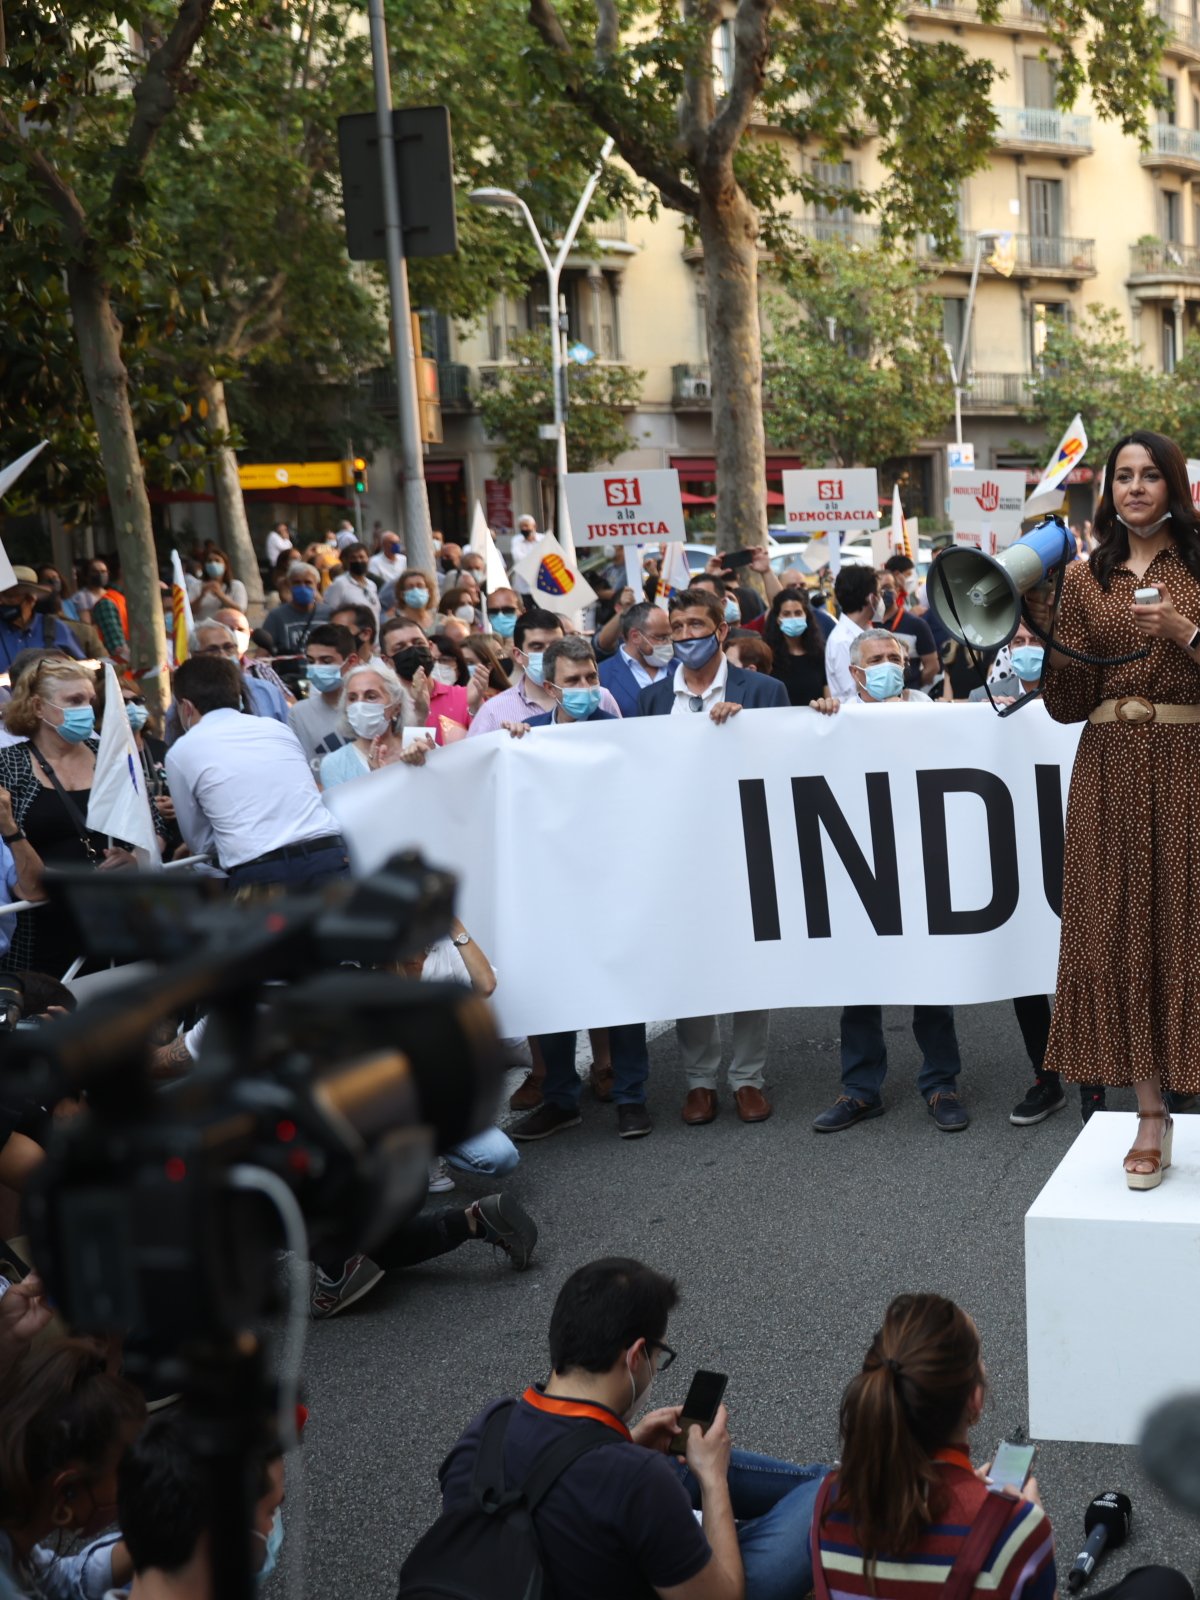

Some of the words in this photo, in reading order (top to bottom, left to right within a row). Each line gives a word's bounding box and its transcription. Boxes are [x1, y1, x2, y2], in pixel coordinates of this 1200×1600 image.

[608, 478, 638, 504] SÍ
[820, 480, 841, 499] SÍ
[831, 502, 838, 510] la
[617, 510, 623, 519] a
[625, 508, 635, 519] la
[789, 510, 875, 522] DEMOCRACIA
[587, 522, 669, 539] JUSTICIA
